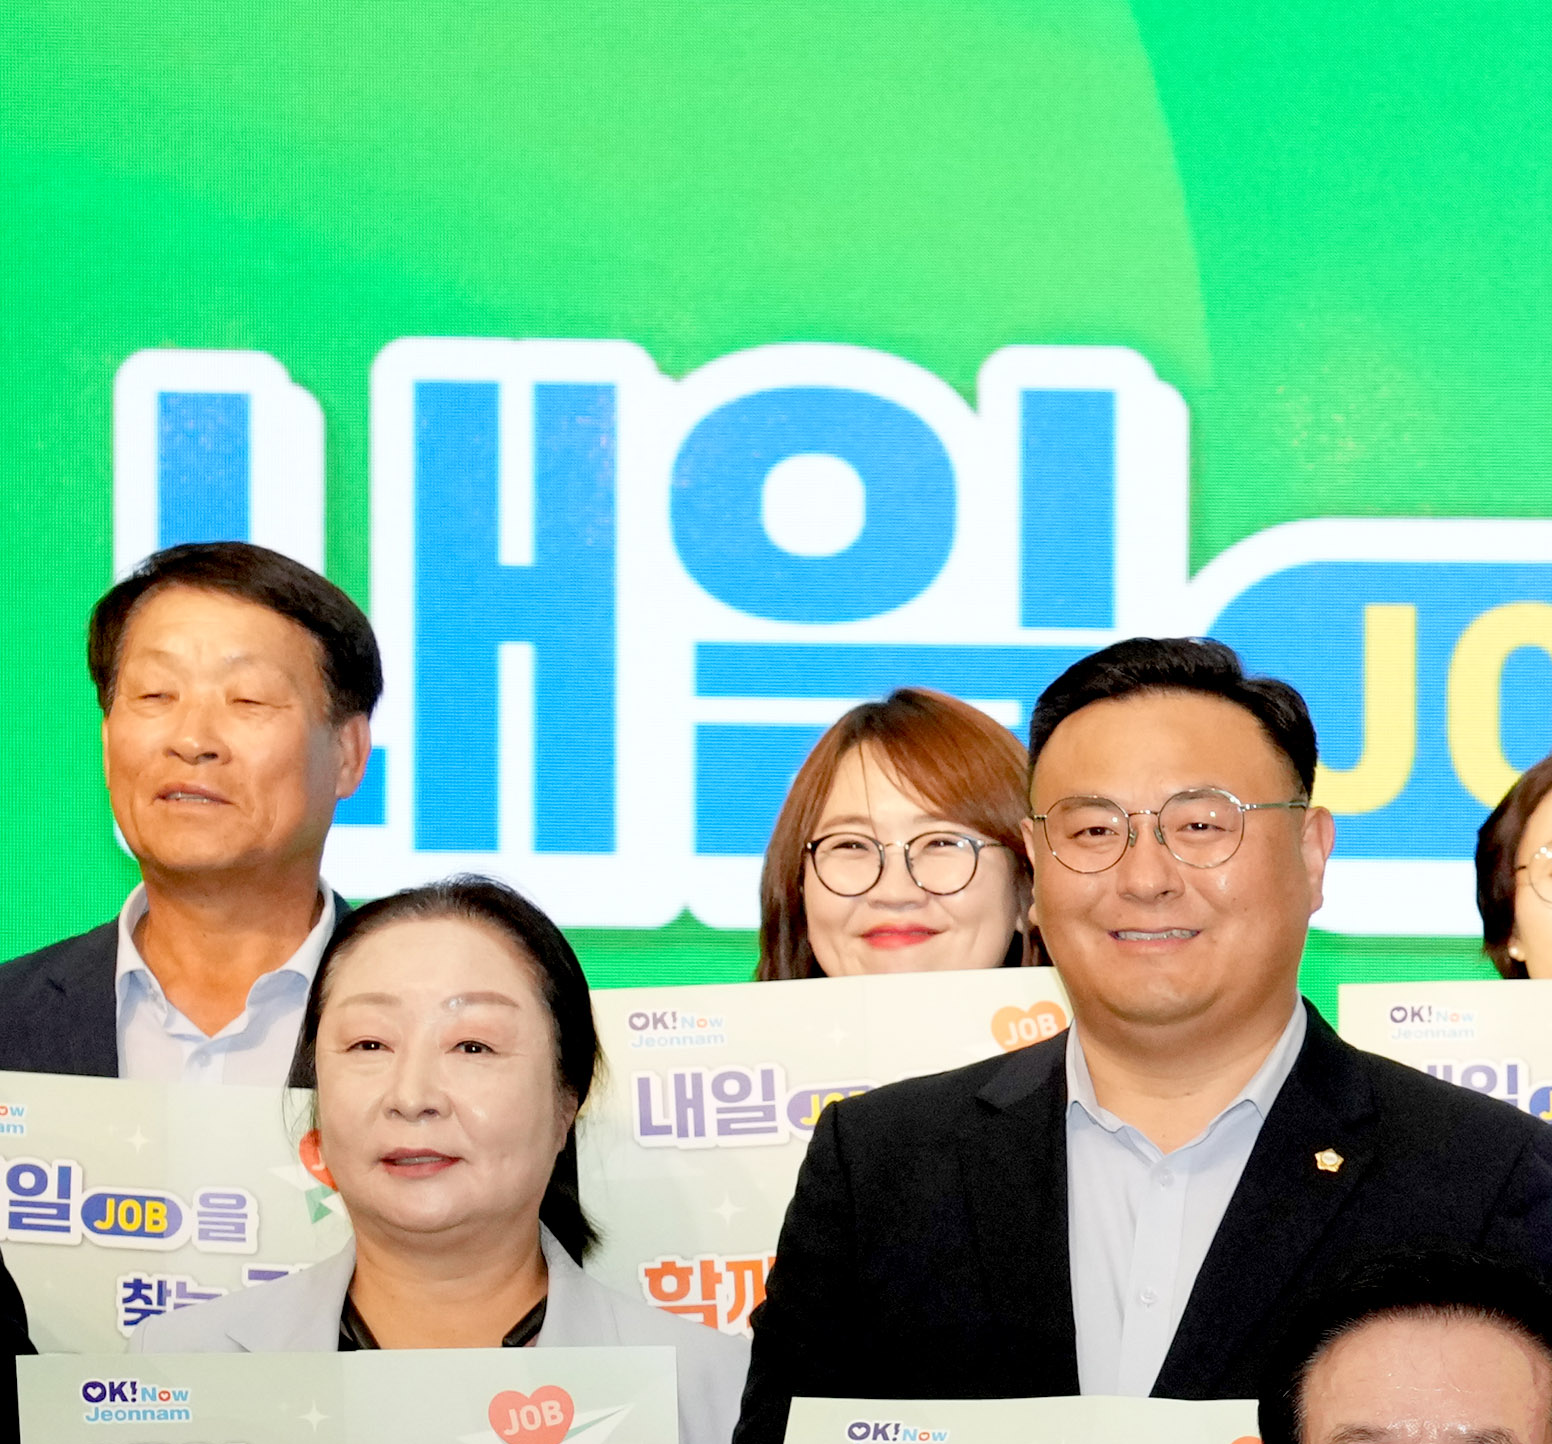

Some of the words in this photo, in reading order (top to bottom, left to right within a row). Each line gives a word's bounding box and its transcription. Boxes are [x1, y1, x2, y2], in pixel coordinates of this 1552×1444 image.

[156, 380, 1123, 856] 내일
[628, 1012, 678, 1032] OK!
[682, 1015, 723, 1029] Now
[1390, 1006, 1432, 1023] OK!
[1003, 1011, 1058, 1047] JOB
[632, 1032, 725, 1049] Jeonnam
[637, 1069, 778, 1139] 내일
[94, 1198, 168, 1233] JOB
[197, 1192, 248, 1243] 을
[82, 1381, 138, 1403] OK!
[141, 1386, 189, 1402] Now
[85, 1405, 190, 1422] Jeonnam
[502, 1399, 564, 1436] JOB
[847, 1422, 900, 1443] OK!
[903, 1428, 947, 1441] Now
